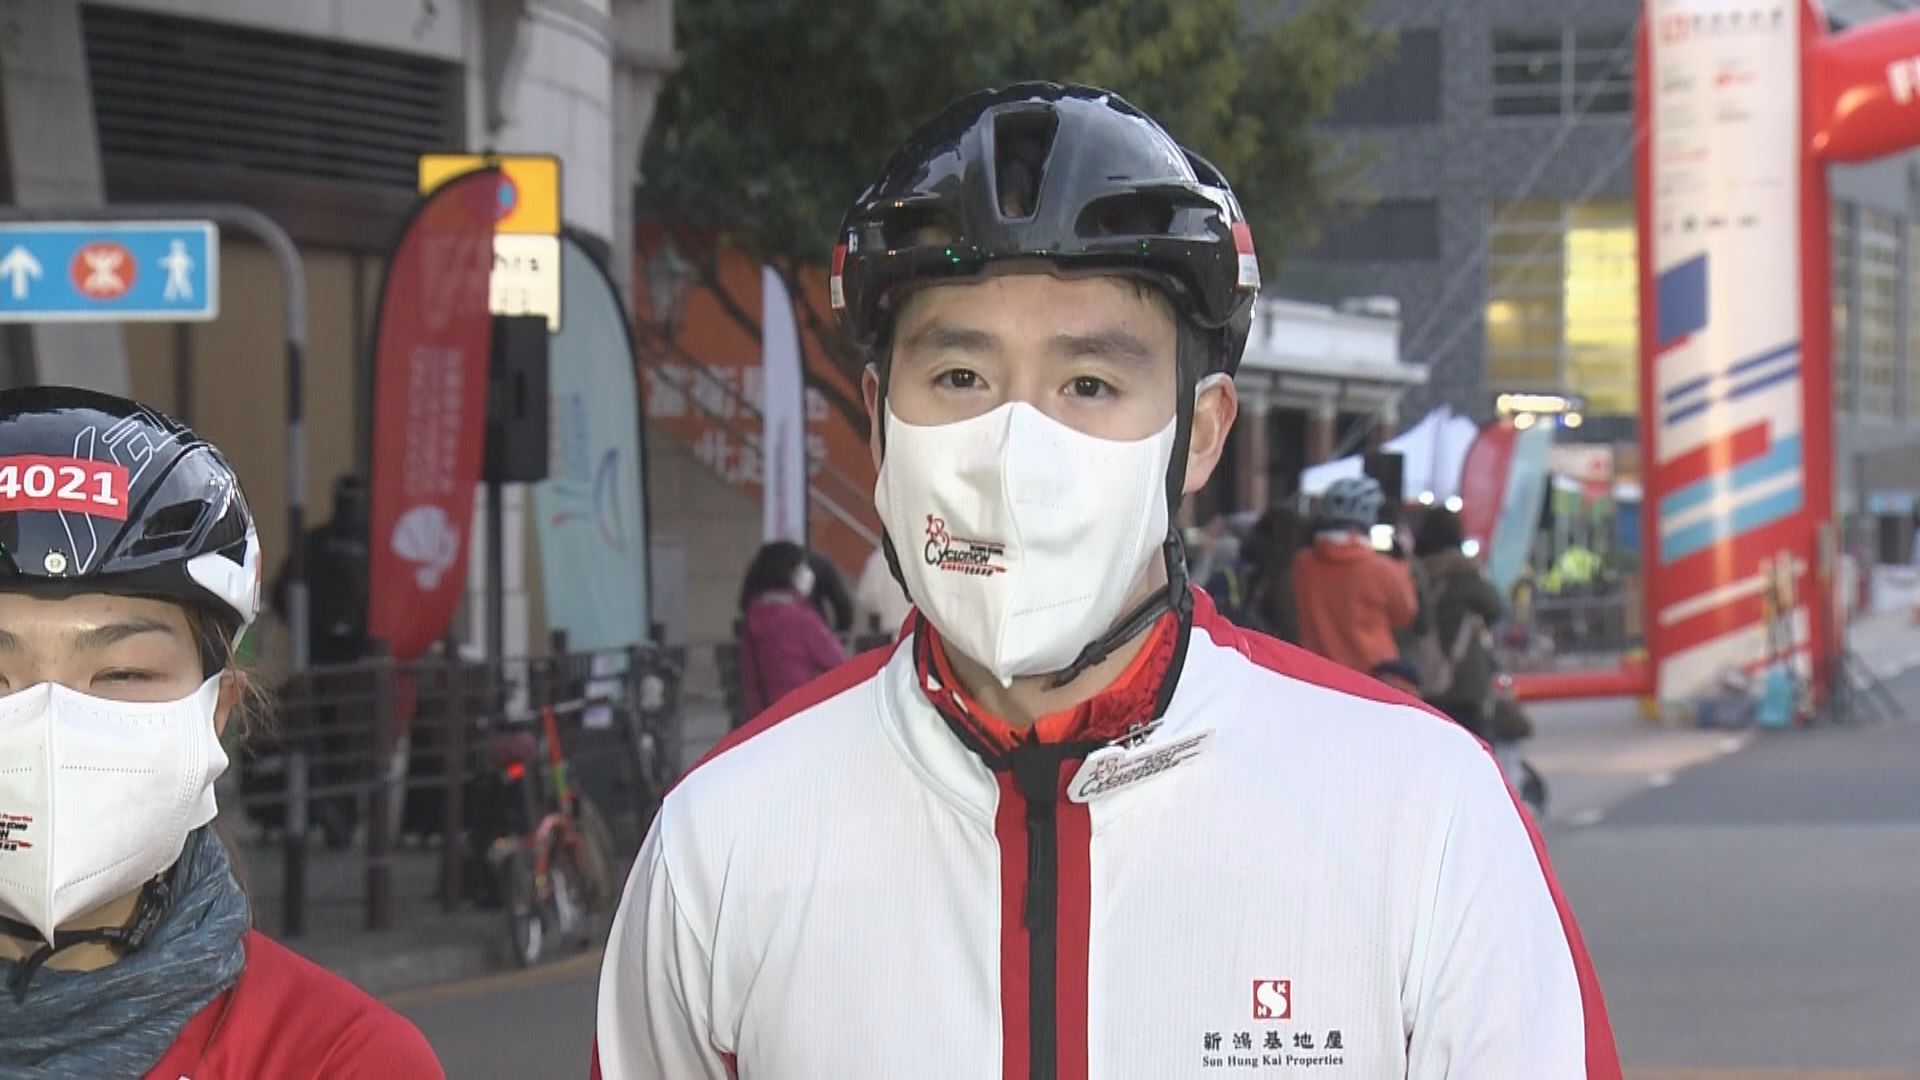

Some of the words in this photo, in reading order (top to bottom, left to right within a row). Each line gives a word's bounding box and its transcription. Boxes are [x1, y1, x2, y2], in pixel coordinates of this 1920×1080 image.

[0, 464, 119, 506] 4021
[1203, 1056, 1223, 1068] Sun
[1228, 1056, 1259, 1068] Hung
[1262, 1055, 1282, 1066] Kai
[1286, 1055, 1344, 1067] Properties
